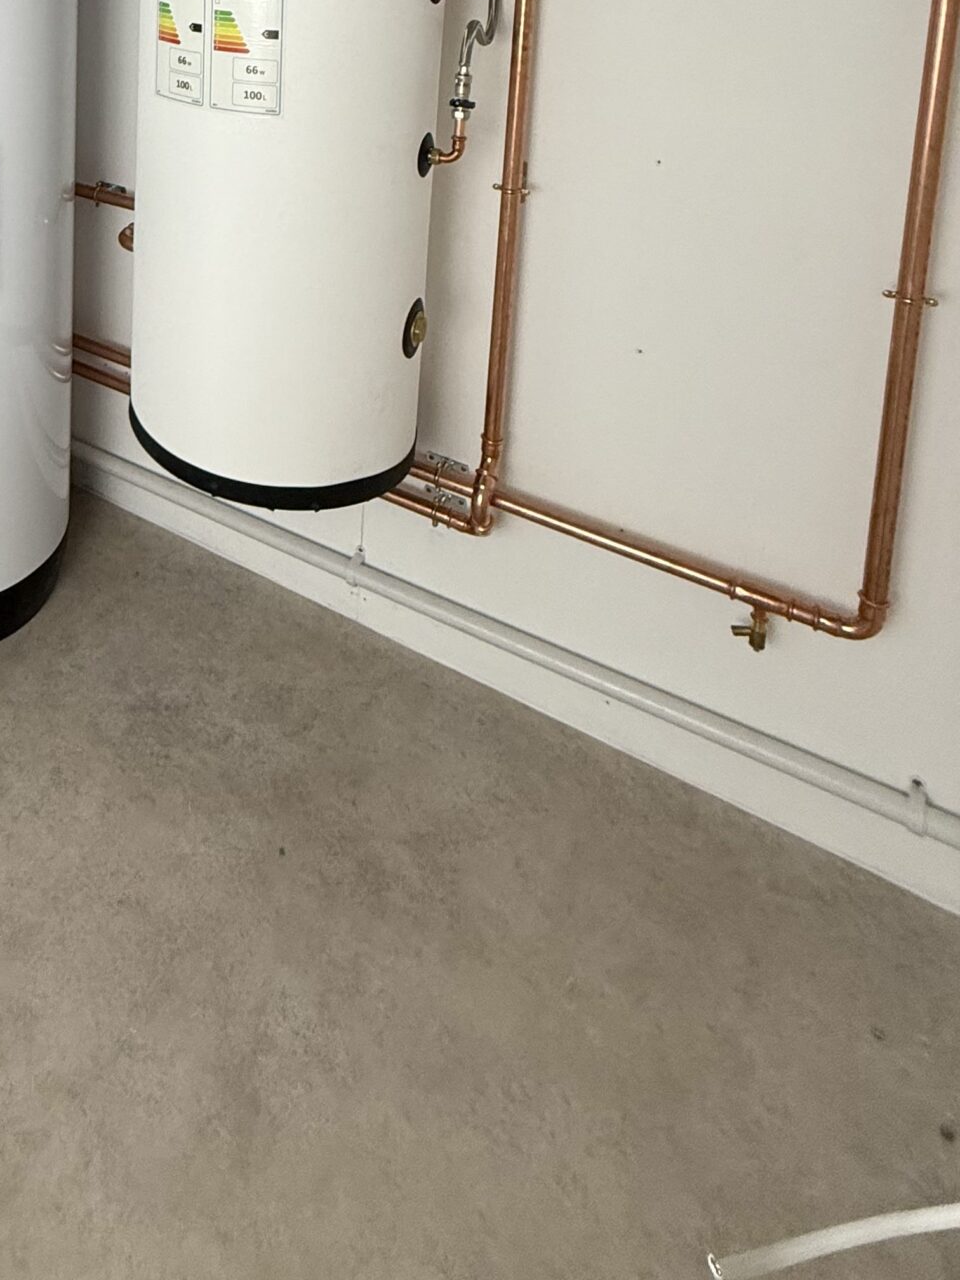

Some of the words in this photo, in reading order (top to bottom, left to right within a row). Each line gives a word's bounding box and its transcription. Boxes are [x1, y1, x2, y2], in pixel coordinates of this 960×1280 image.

[178, 55, 187, 66] 66
[245, 65, 258, 75] 66
[176, 80, 189, 91] 100
[243, 90, 262, 100] 100
